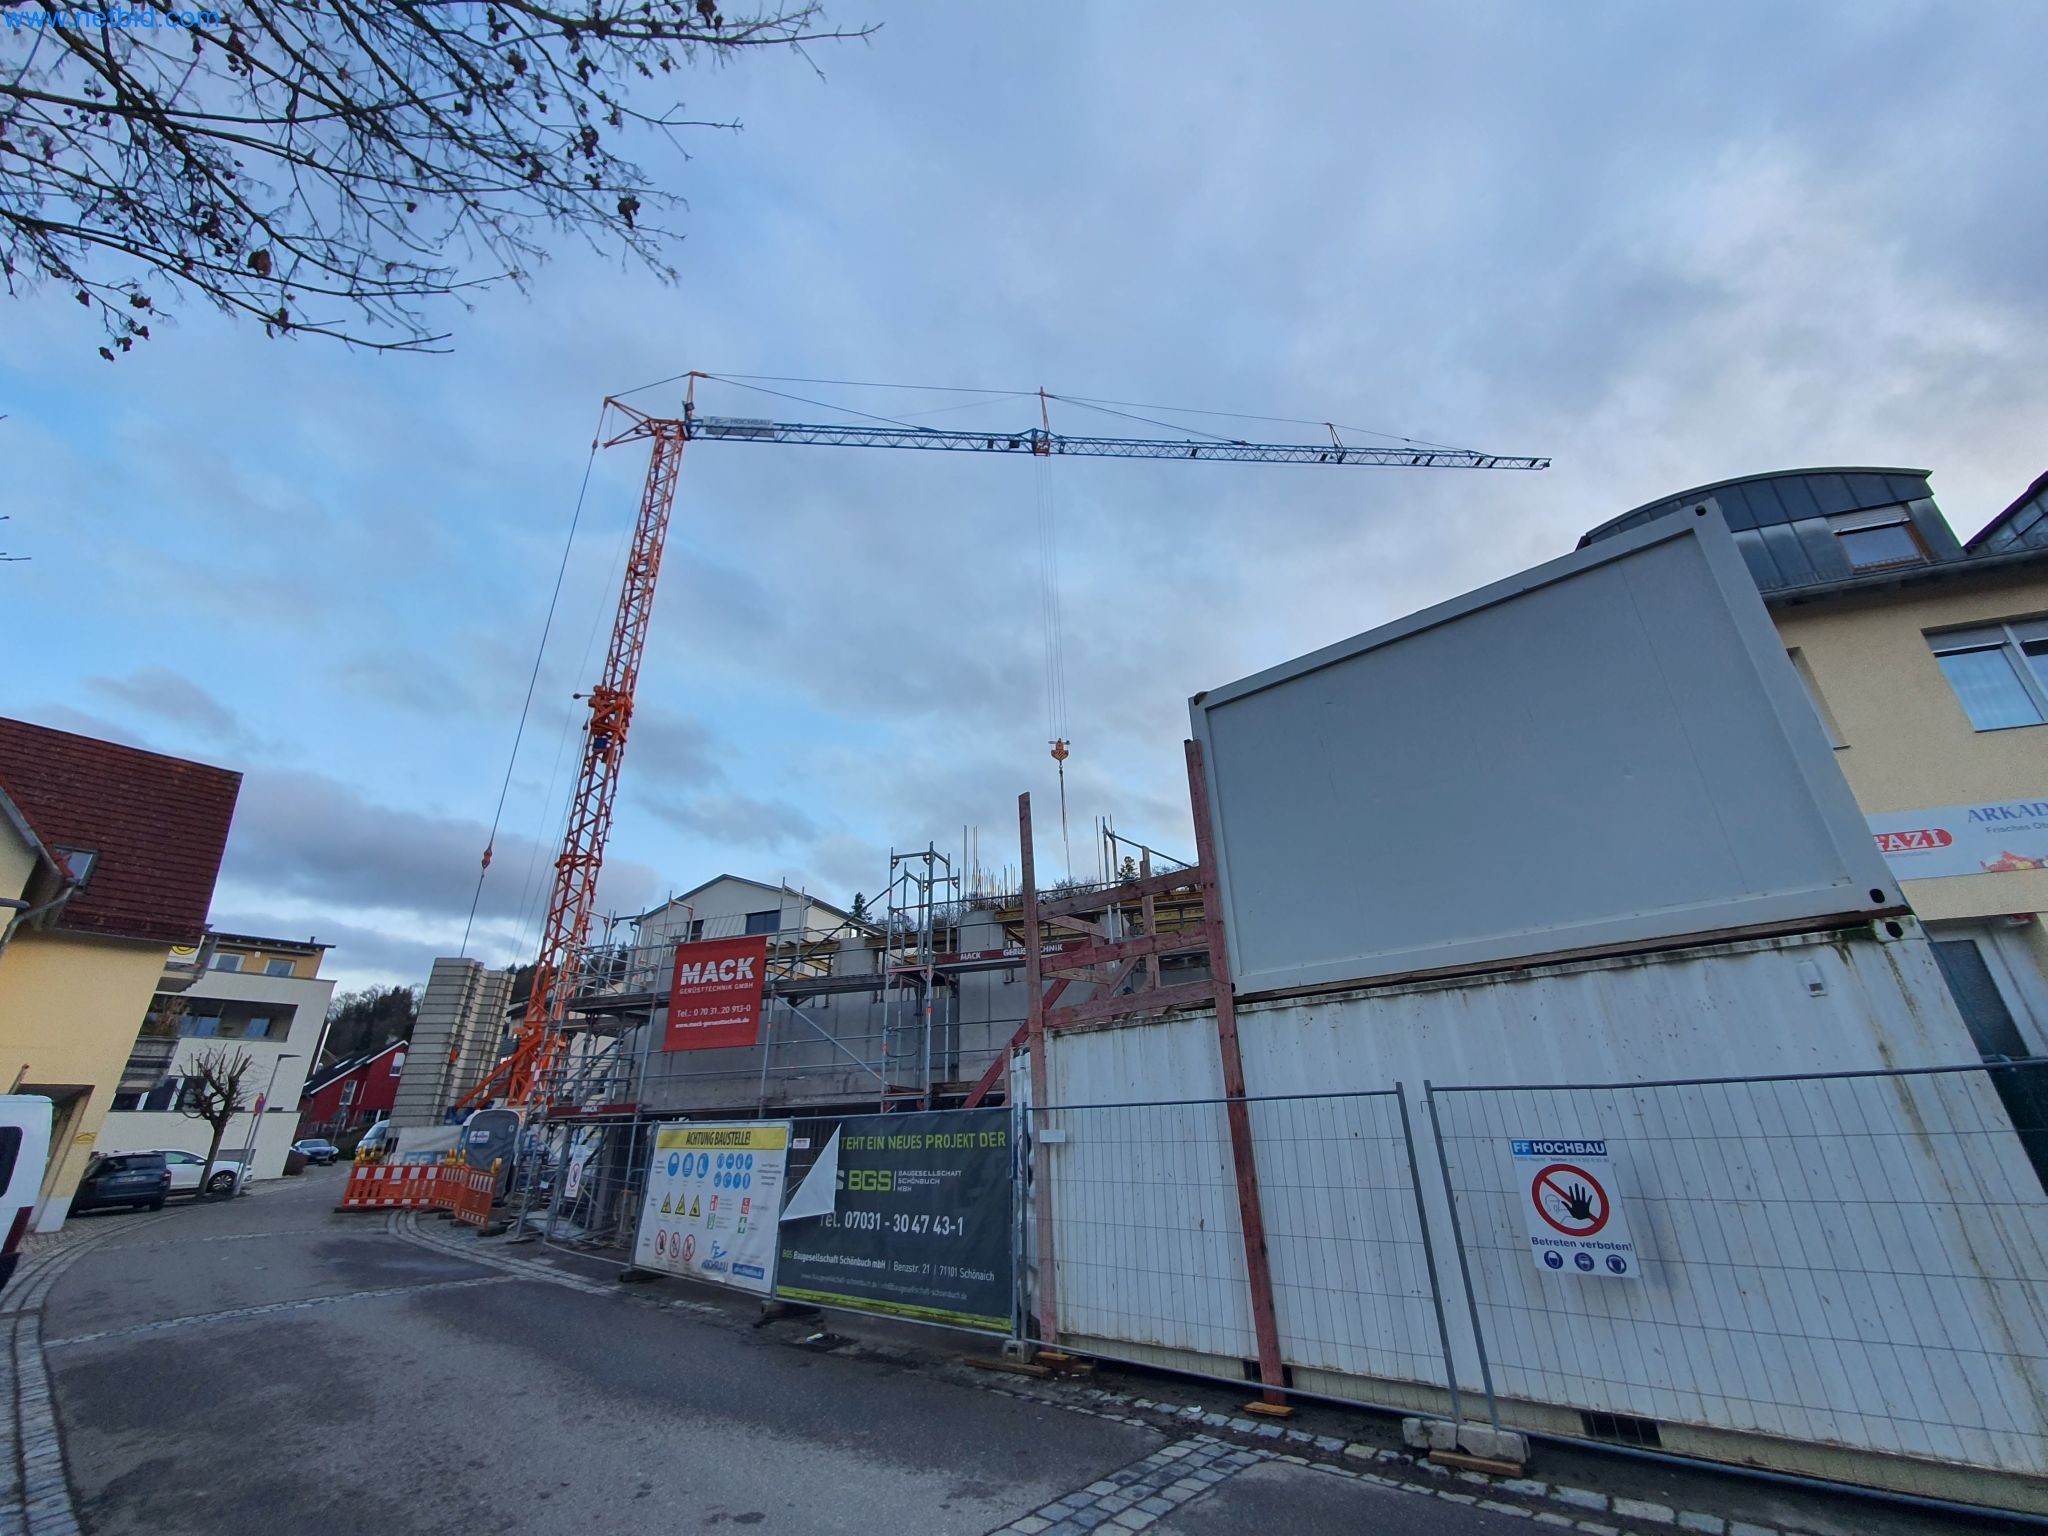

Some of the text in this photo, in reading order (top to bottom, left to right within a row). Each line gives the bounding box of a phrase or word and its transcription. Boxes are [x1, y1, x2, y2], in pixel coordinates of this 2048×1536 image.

[960, 952, 981, 961] MACK
[680, 956, 756, 986] MACK
[679, 984, 733, 995] GERÜSTTECHNIK
[693, 1008, 699, 1016] 0
[700, 1007, 709, 1016] 70
[686, 1131, 714, 1146] ACHTUNG
[867, 1136, 885, 1150] EIN
[888, 1135, 922, 1149] NEUES
[925, 1133, 976, 1149] PROJEKT
[979, 1132, 1006, 1147] DER
[1513, 1142, 1606, 1154] FF HOCHBAU
[848, 1170, 892, 1191] BGS
[897, 1177, 940, 1185] SCHÖNBUCH
[845, 1211, 881, 1230] 07031
[893, 1214, 909, 1233] 30
[911, 1214, 930, 1234] 47
[933, 1215, 964, 1236] 43-1
[1531, 1236, 1632, 1251] Betreten verboten!
[793, 1250, 839, 1264] Baugesellschaft
[840, 1255, 872, 1268] Schönbuch
[872, 1260, 886, 1269] mbH
[894, 1261, 920, 1273] Benzstr.
[922, 1264, 930, 1274] 21
[940, 1265, 958, 1277] 71101
[960, 1267, 995, 1281] Schönaich
